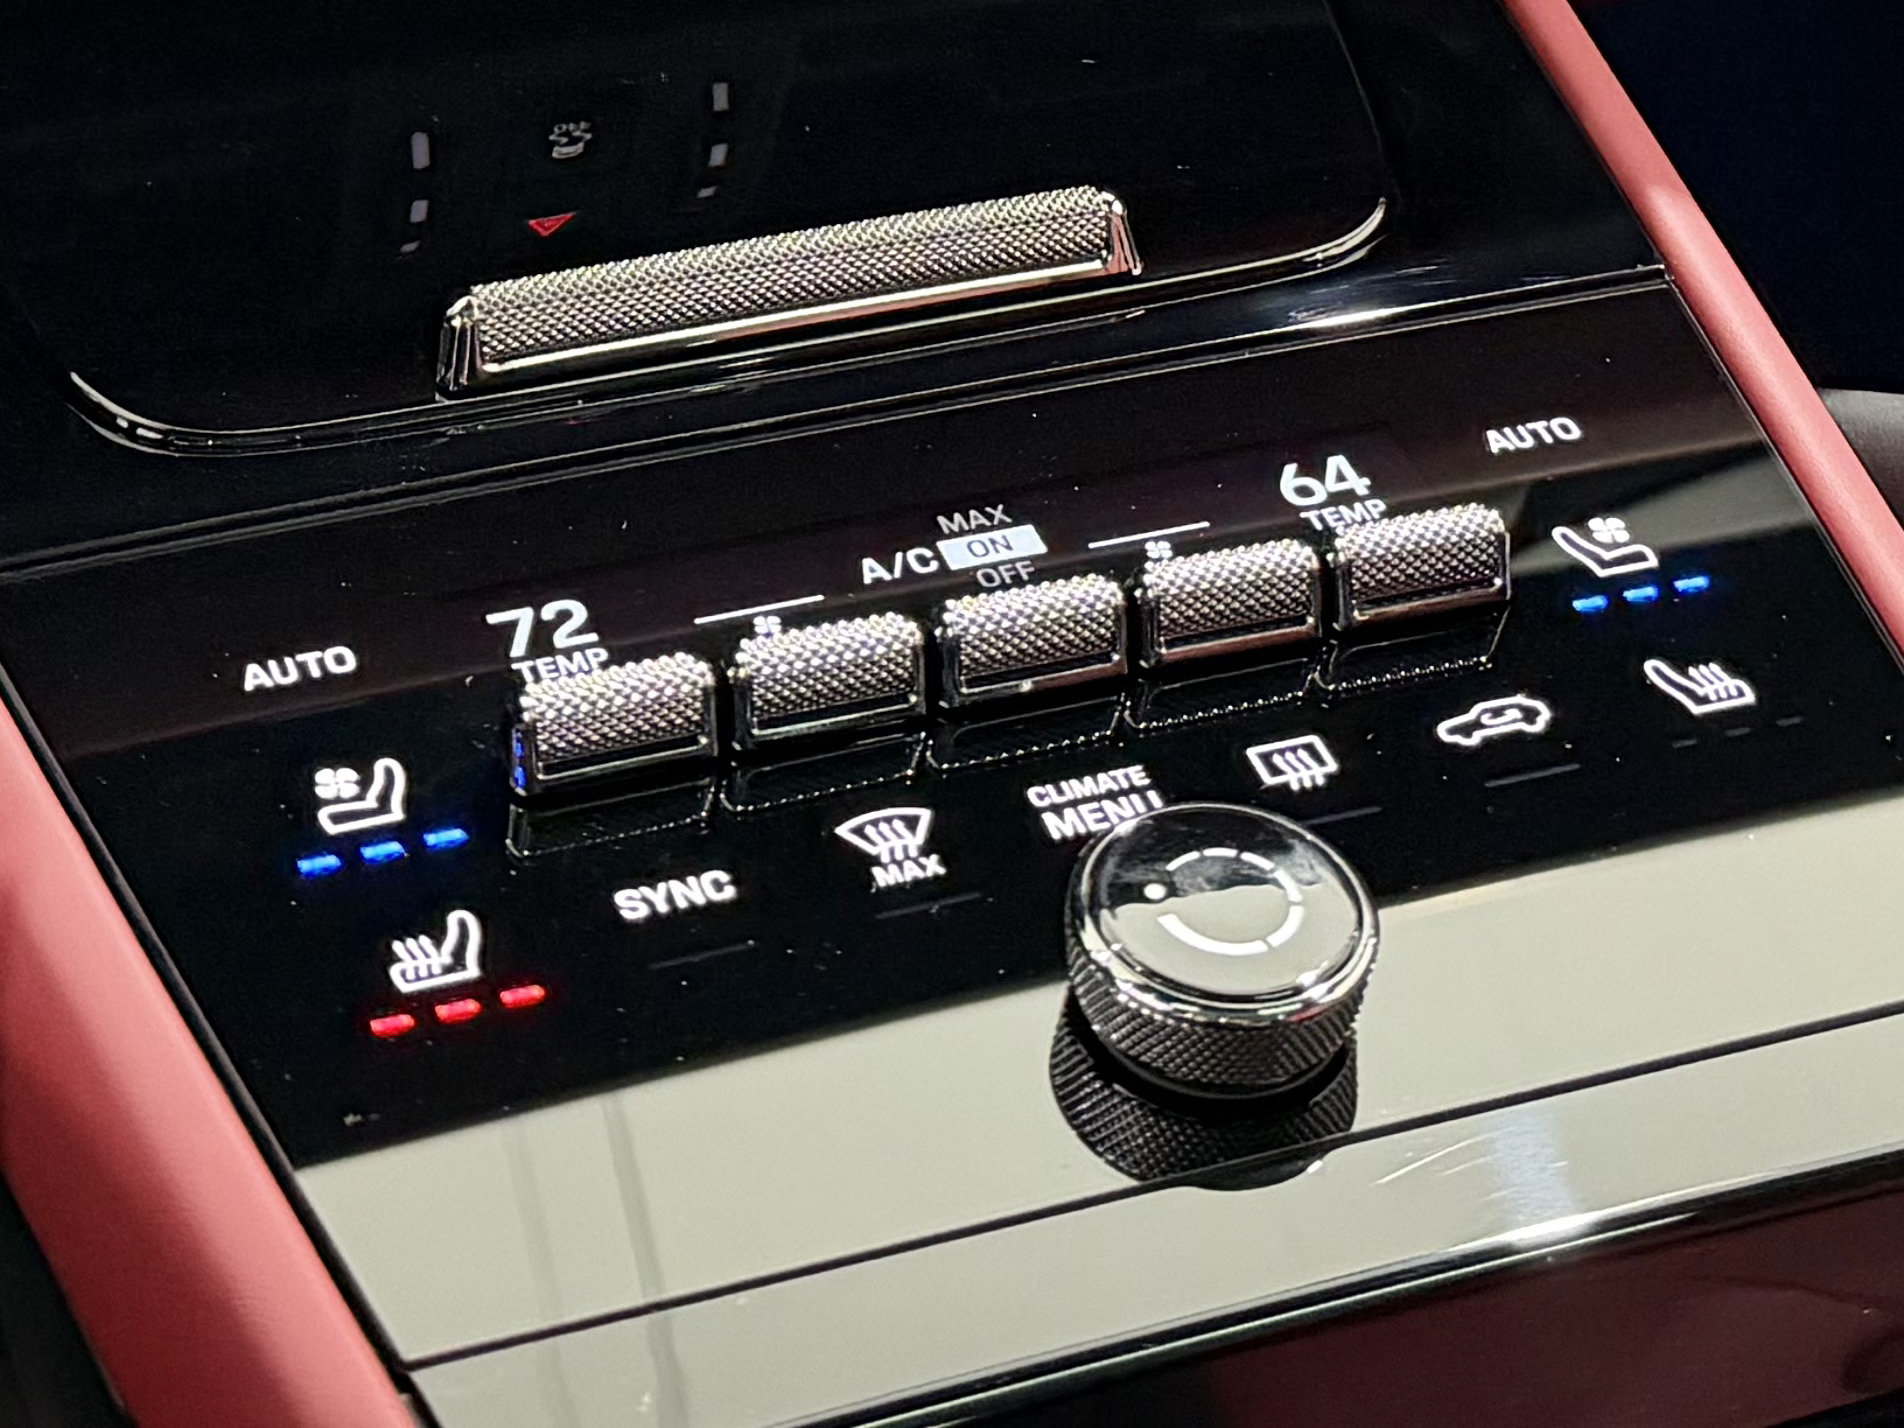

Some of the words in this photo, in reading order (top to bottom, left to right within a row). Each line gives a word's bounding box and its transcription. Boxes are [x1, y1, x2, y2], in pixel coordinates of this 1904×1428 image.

[1485, 417, 1582, 454] AUTO
[1279, 454, 1372, 506] 64
[937, 504, 1013, 534] MAX
[1299, 499, 1388, 533] TEMP
[862, 547, 939, 585] A/C
[966, 535, 1014, 558] ON
[976, 560, 1036, 588] OFF
[485, 599, 600, 658] 72
[244, 645, 357, 691] AUTO
[510, 647, 609, 684] TEMP
[1026, 764, 1152, 808] CLIMATE
[869, 854, 946, 887] MAX
[613, 869, 737, 921] SYNC
